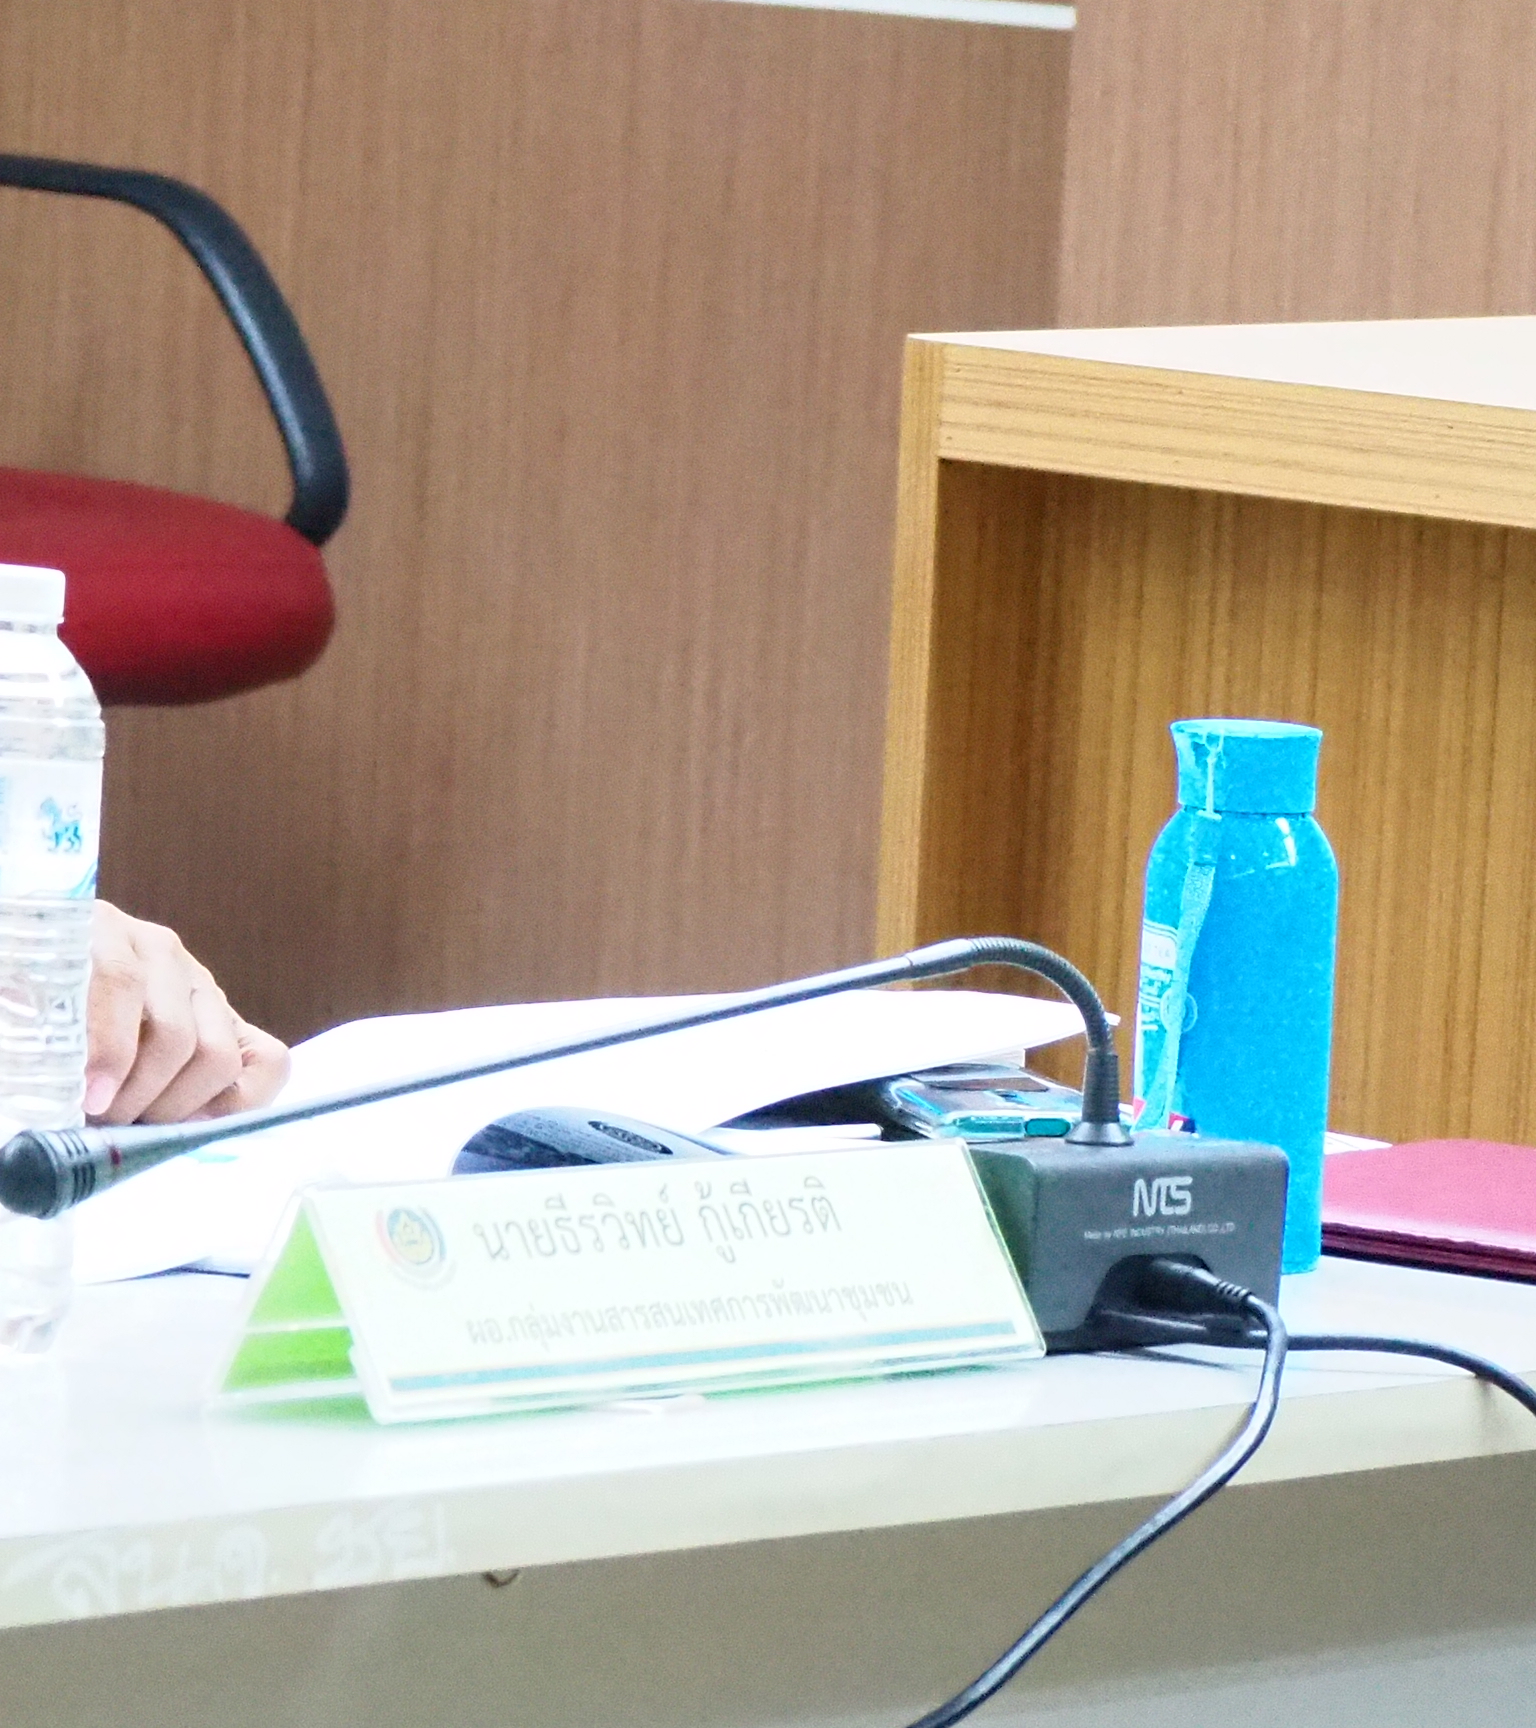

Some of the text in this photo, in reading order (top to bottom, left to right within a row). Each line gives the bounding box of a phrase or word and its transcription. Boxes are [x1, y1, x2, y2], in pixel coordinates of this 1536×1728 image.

[473, 1175, 842, 1264] นายธีรวิทย์ กู้เกียรติ
